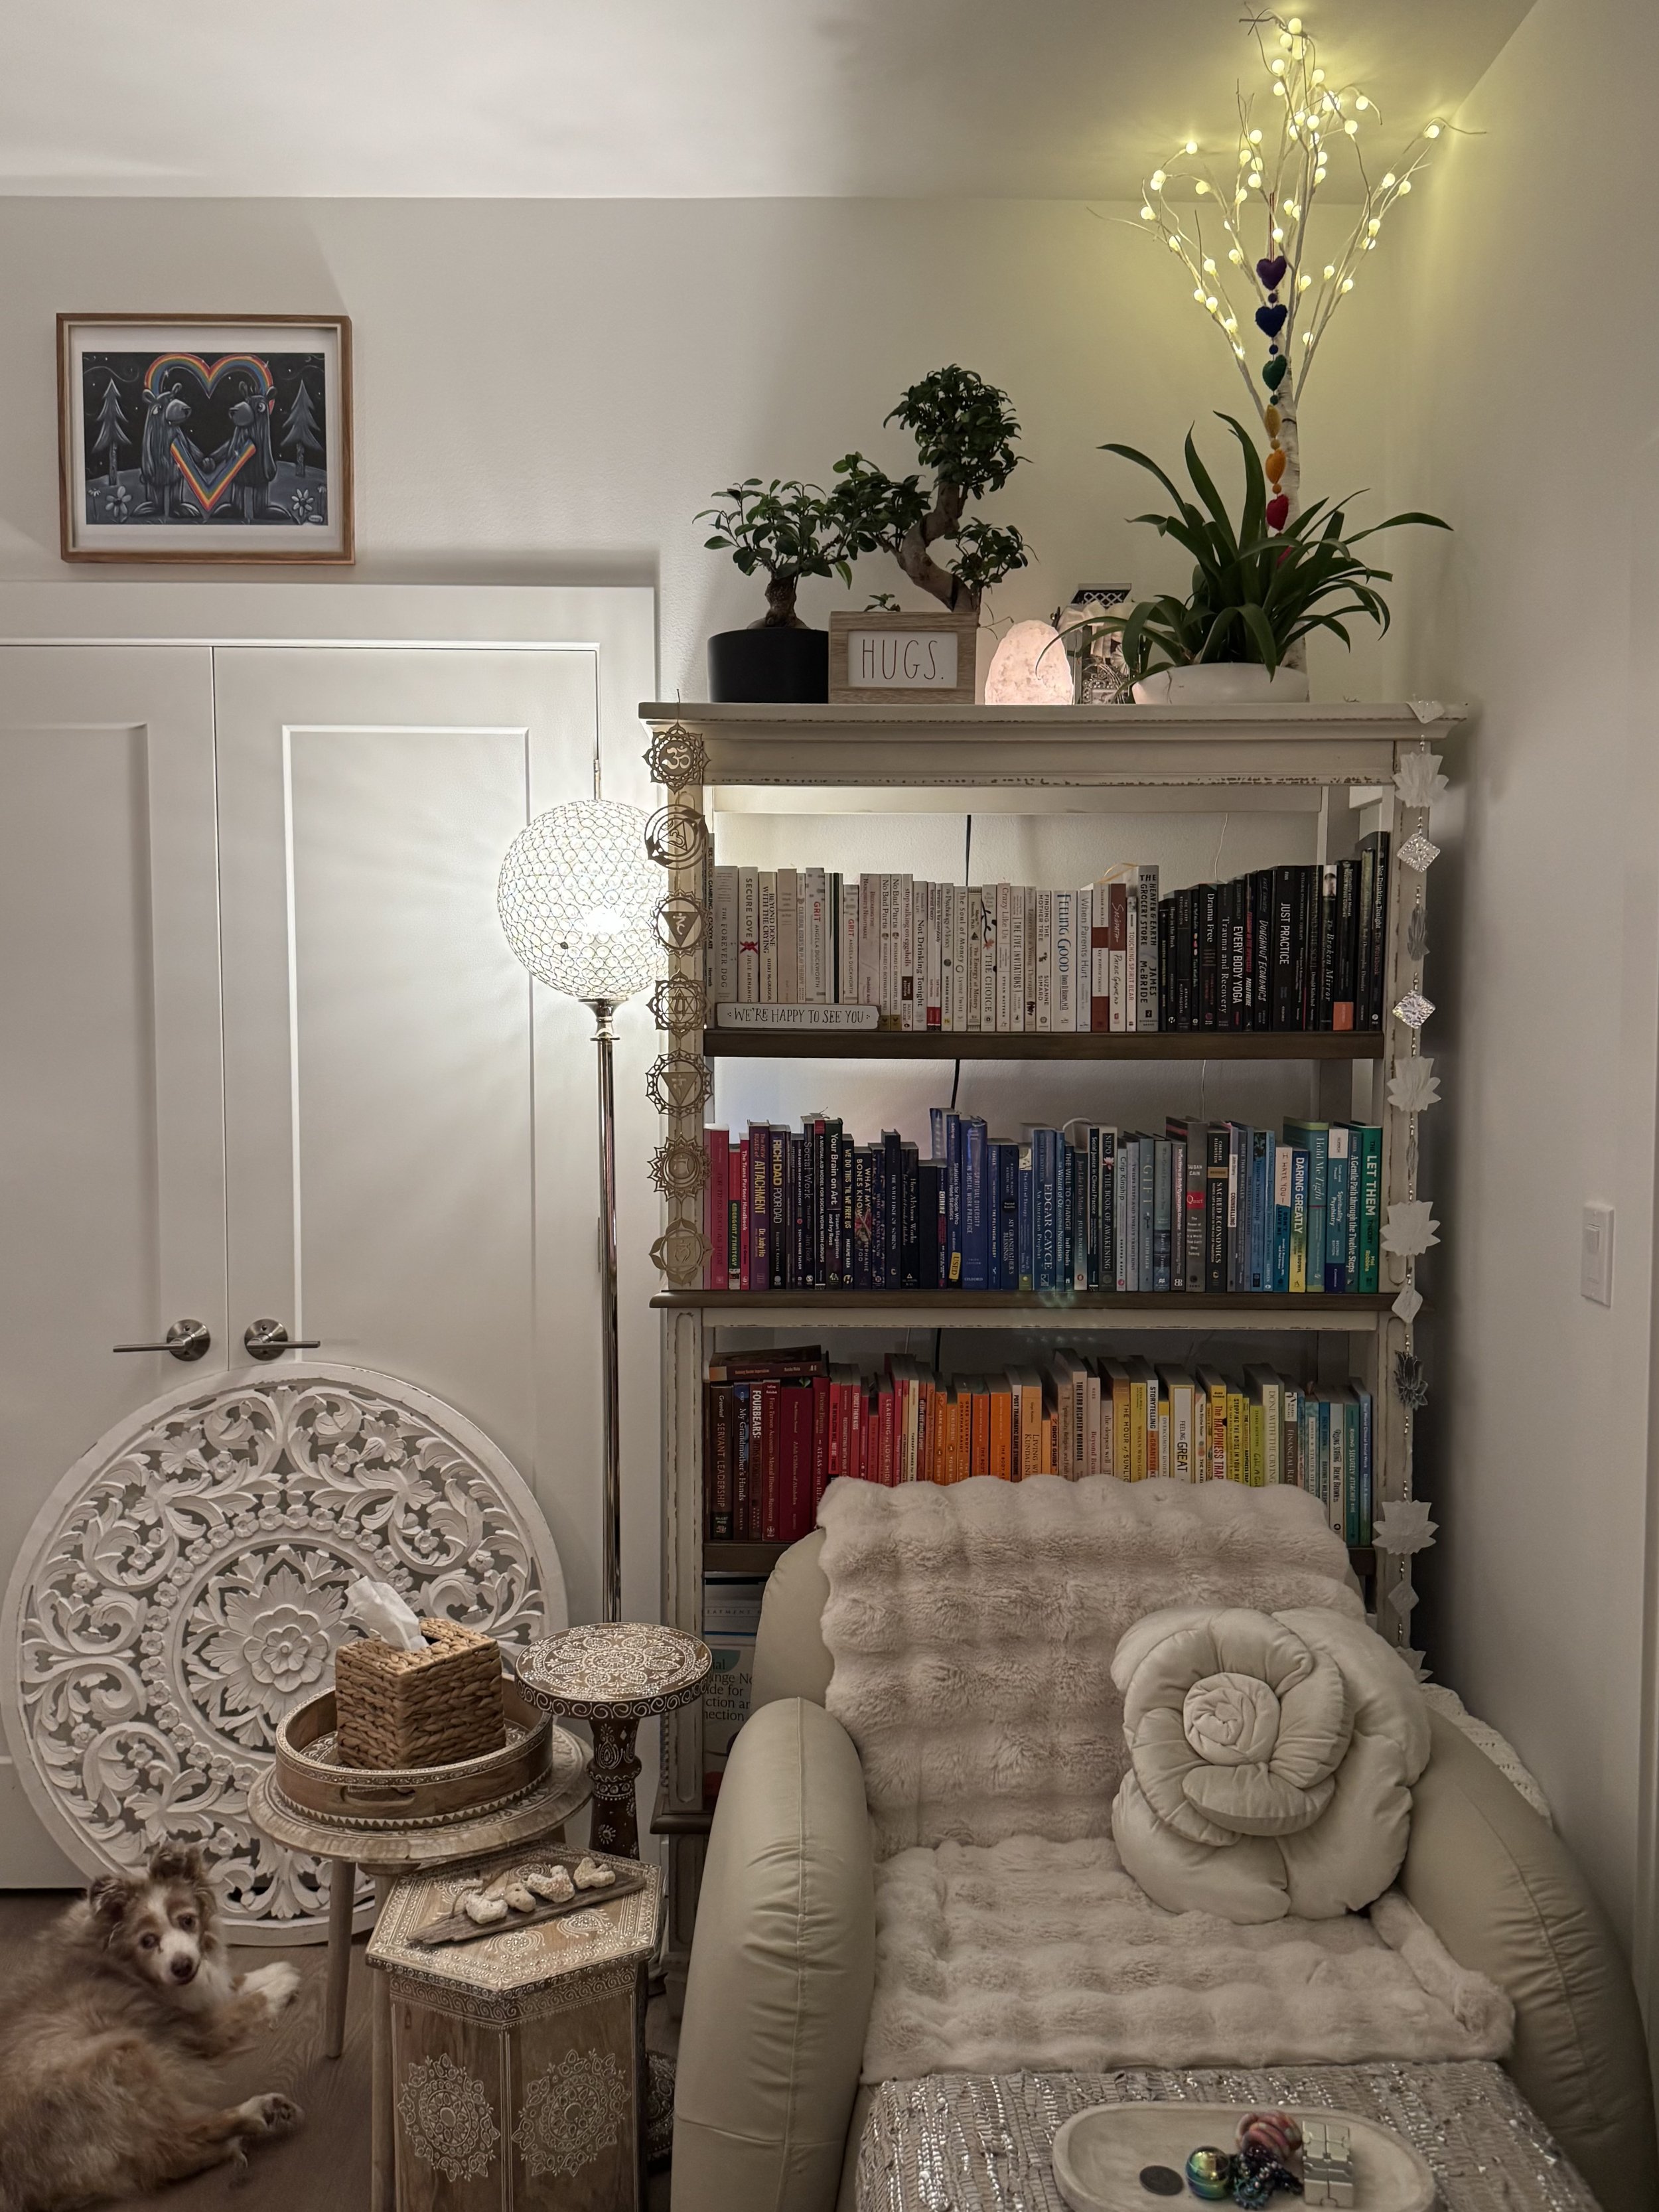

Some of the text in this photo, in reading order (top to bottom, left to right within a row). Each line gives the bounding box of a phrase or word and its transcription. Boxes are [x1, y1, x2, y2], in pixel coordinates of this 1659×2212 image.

[862, 638, 945, 680] HUGS.
[883, 879, 889, 891] No
[893, 879, 899, 889] No
[1375, 877, 1384, 905] Drinking
[1206, 893, 1215, 921] Drama
[1002, 929, 1009, 939] Us
[1013, 922, 1022, 933] THE
[1057, 894, 1071, 972] FEELING GOOD
[1279, 902, 1291, 965] JUST PRACTICE
[1013, 935, 1022, 948] FIVE
[1326, 933, 1334, 965] Broken
[916, 937, 924, 974] Drinking
[1218, 917, 1230, 1013] Trauma and Recovery
[1232, 926, 1243, 1003] EVERY BODY YOGA
[1258, 920, 1268, 1001] DOUGHNUT ECONOMICS
[1013, 950, 1022, 988] INVITATIONS
[916, 976, 924, 1007] Tonight
[1325, 970, 1334, 1001] Mirror
[734, 1007, 864, 1024] WE'RE HAPPY TO SEE YOU
[772, 1140, 783, 1161] RICH
[1315, 1138, 1325, 1159] Hold
[772, 1163, 783, 1185] DAD
[803, 1142, 812, 1199] Social Work
[1315, 1161, 1325, 1175] Me
[1350, 1161, 1358, 1181] Gentle
[1367, 1155, 1376, 1177] LET
[754, 1160, 766, 1215] ATTACHMENT
[831, 1179, 836, 1189] on
[1065, 1187, 1071, 1196] TO
[1294, 1157, 1305, 1234] DARING GREATLY
[1314, 1176, 1325, 1201] Tight
[864, 1195, 871, 1207] MY
[1348, 1197, 1358, 1221] through
[1366, 1180, 1376, 1216] THEM
[1043, 1184, 1052, 1270] EDGAR CAYCE
[1104, 1213, 1111, 1222] OF
[1346, 1256, 1356, 1273] Steps
[737, 1408, 746, 1419] My
[752, 1390, 762, 1439] FOURBEARS:
[1213, 1406, 1224, 1479] The HAPPINESS TRAP
[1177, 1441, 1188, 1473] GREAT
[729, 1685, 743, 1696] for
